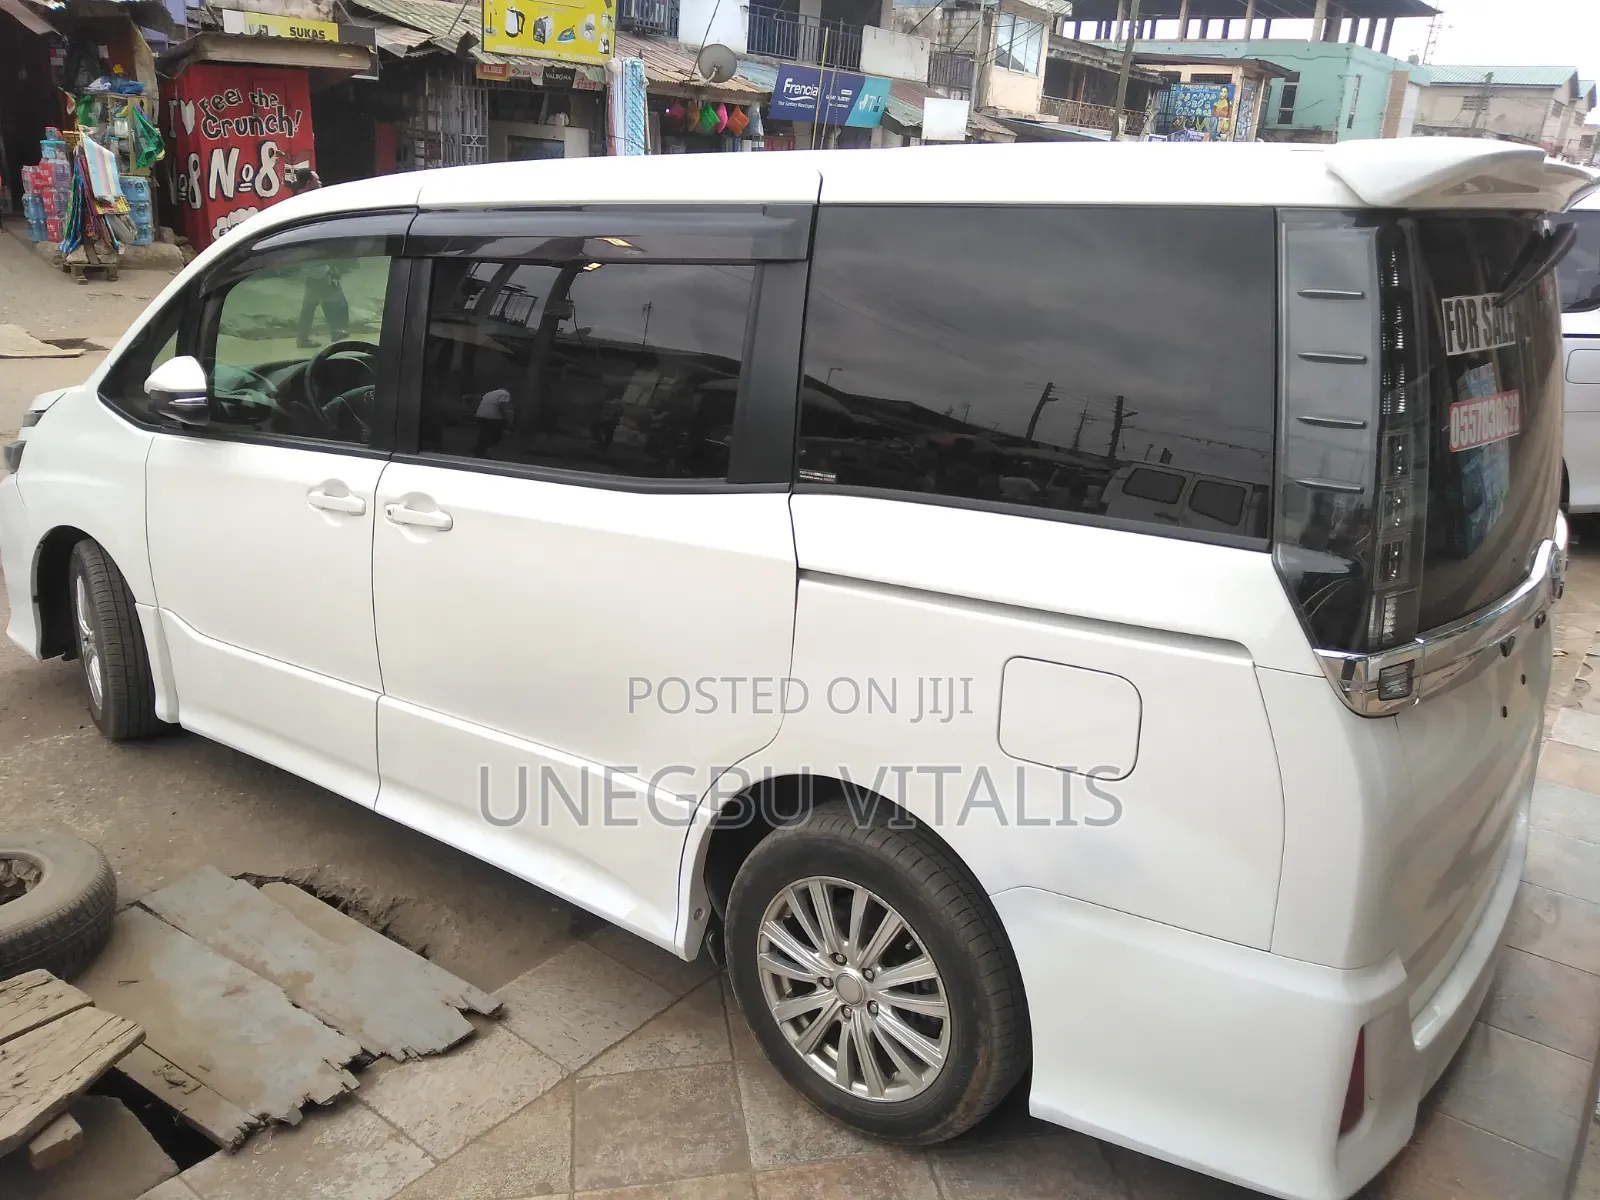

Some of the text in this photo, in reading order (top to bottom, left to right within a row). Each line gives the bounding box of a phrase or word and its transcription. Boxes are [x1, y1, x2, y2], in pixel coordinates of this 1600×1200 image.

[289, 26, 326, 40] SUKAS
[783, 78, 819, 97] Frencia
[198, 88, 279, 117] Feel the
[201, 105, 303, 141] Crunch!
[1443, 298, 1481, 353] FOR
